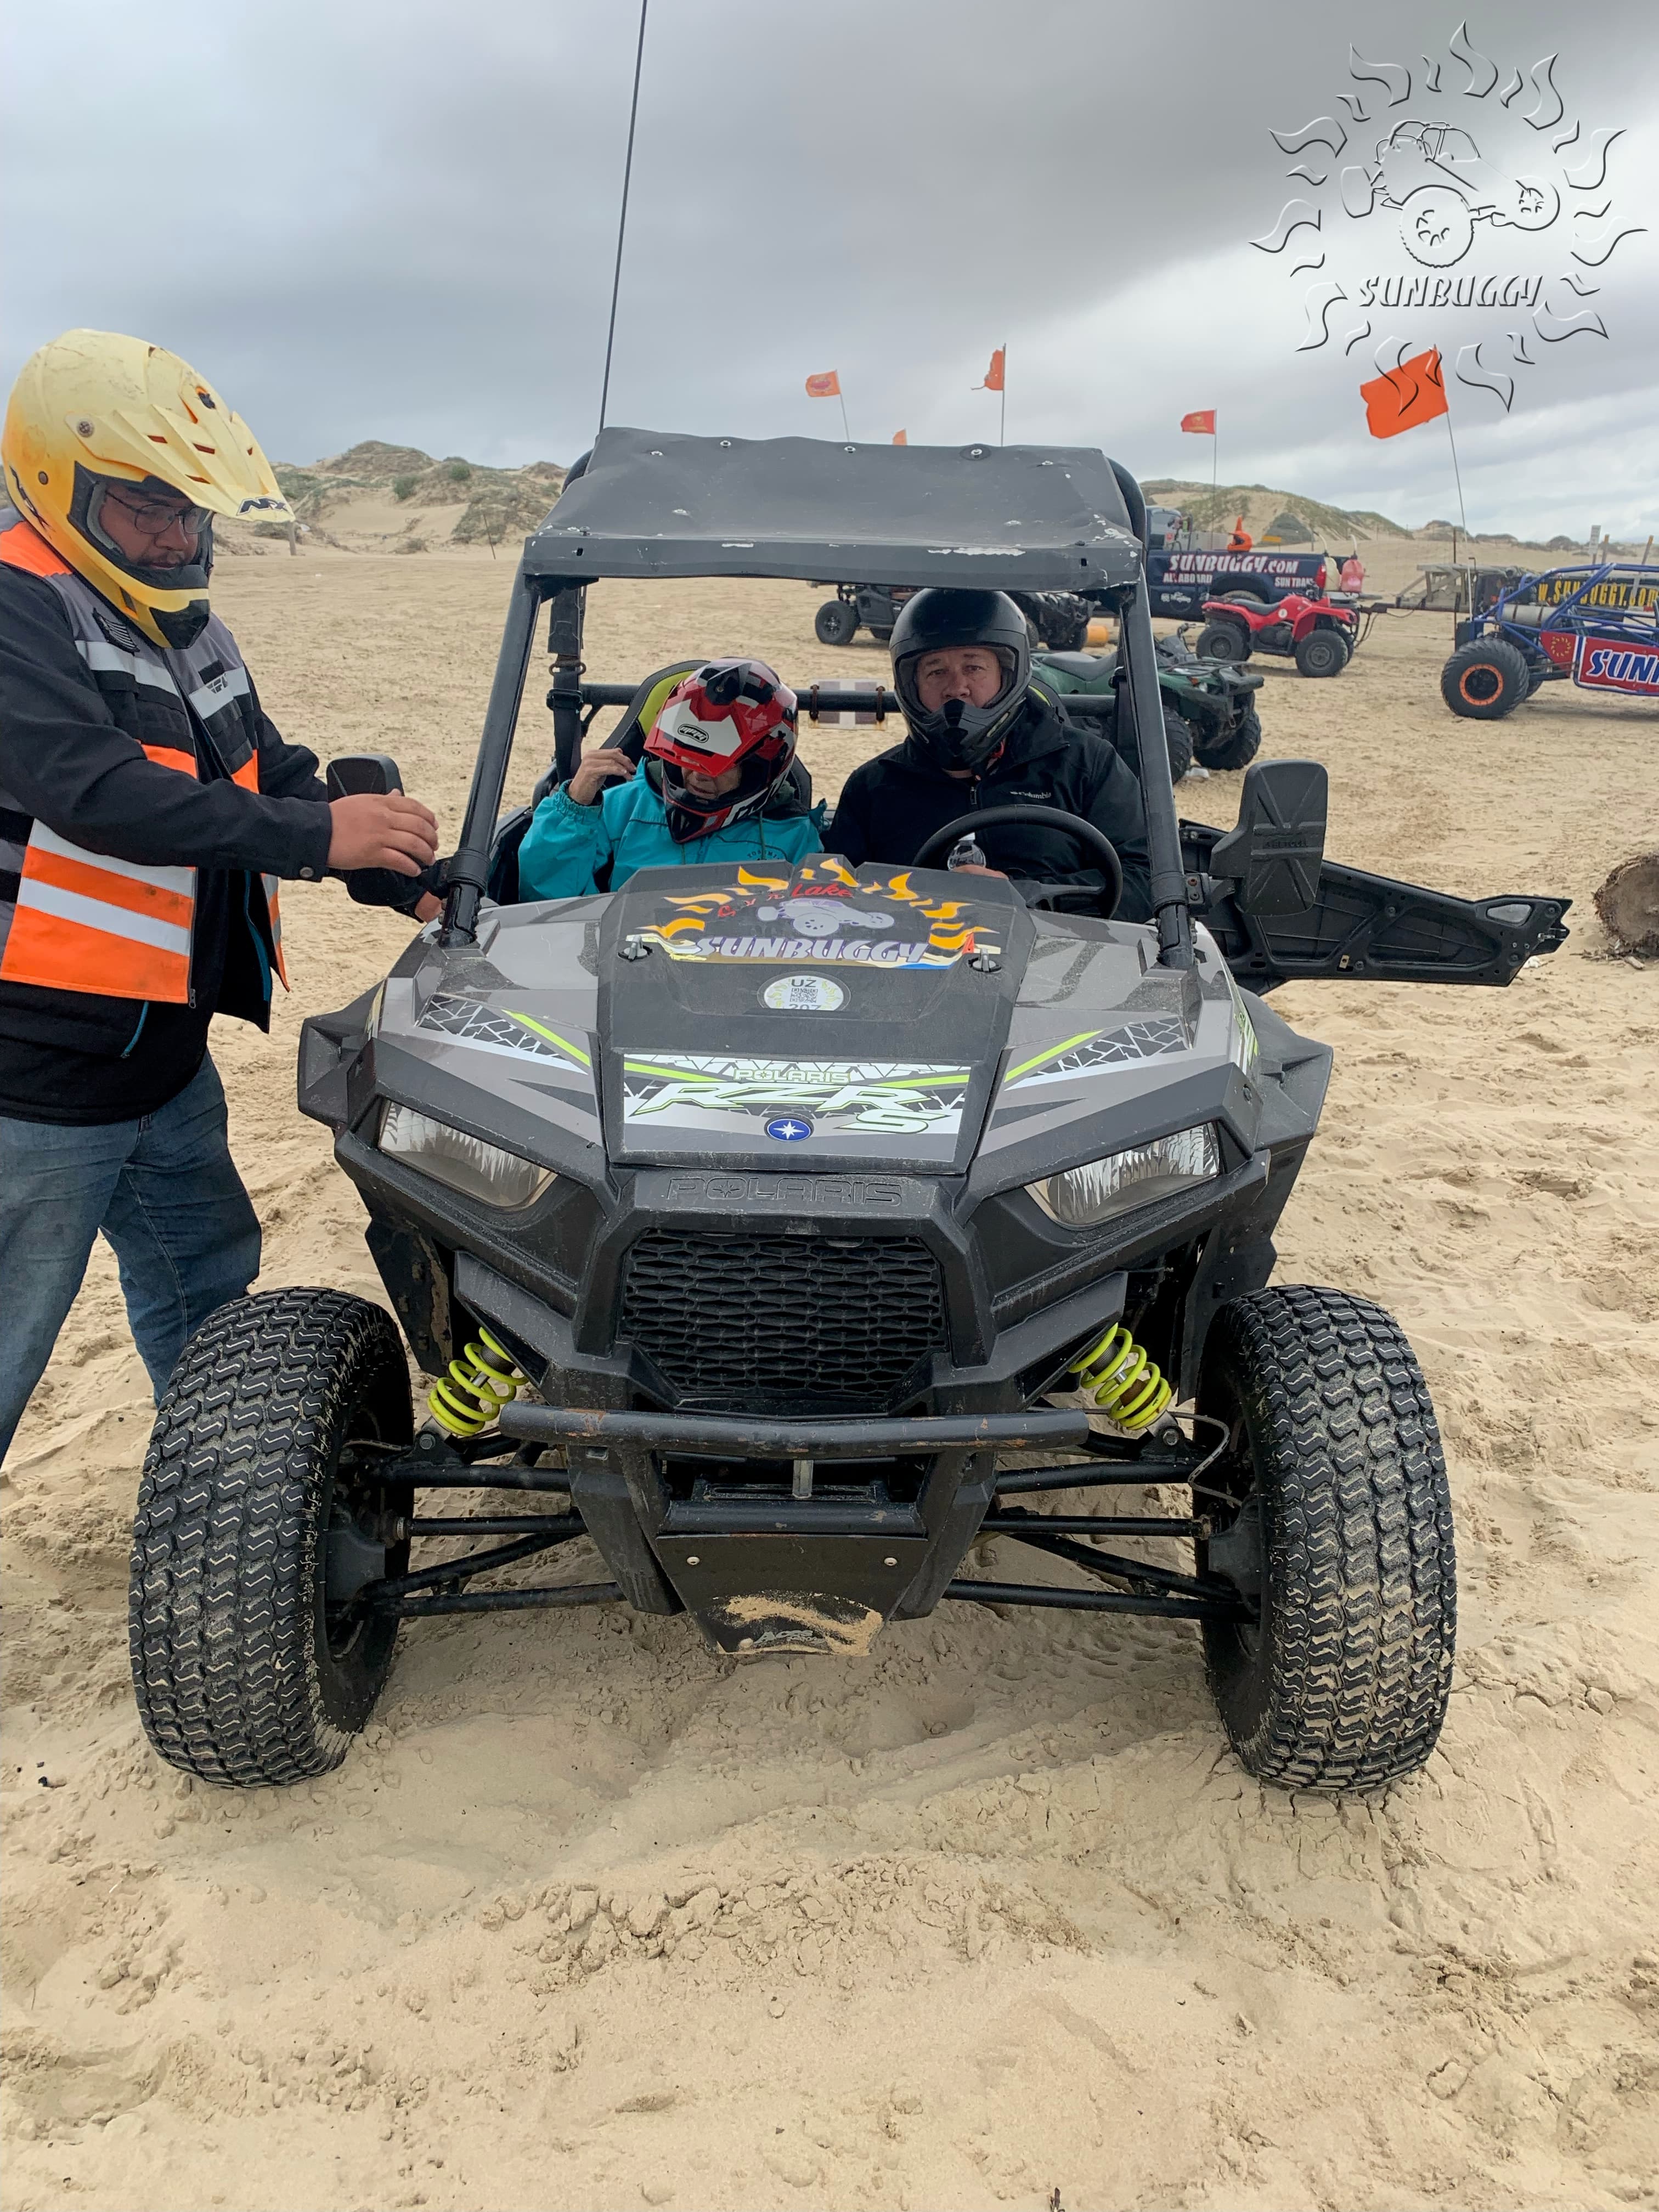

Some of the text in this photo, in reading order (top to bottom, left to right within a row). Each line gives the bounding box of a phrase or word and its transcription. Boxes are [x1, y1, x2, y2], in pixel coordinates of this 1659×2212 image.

[1274, 576, 1290, 588] SUN
[1585, 649, 1659, 686] SUN
[792, 882, 854, 899] Lake
[695, 934, 930, 963] SUNBUGGY
[791, 979, 817, 988] UZ
[733, 1069, 851, 1084] POLARIS
[628, 1082, 952, 1135] RZR S
[666, 1176, 902, 1207] POLARIS
